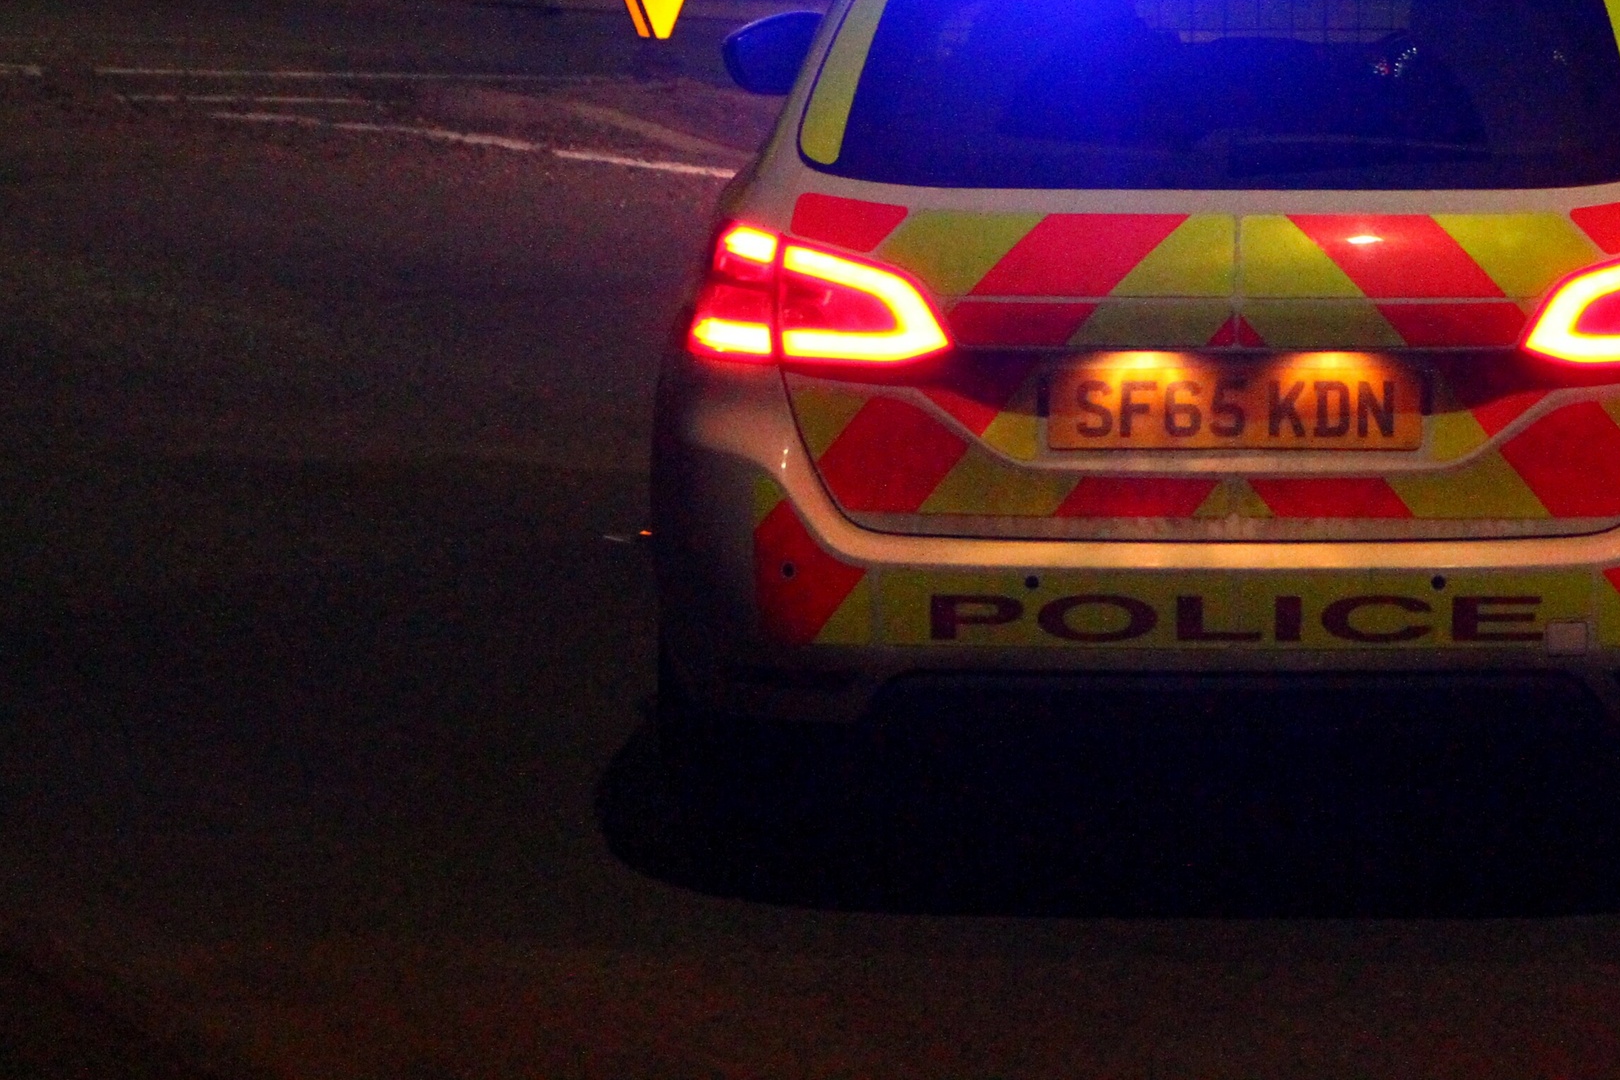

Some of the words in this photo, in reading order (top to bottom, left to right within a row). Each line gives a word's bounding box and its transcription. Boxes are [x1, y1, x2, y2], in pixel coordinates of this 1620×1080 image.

[1075, 380, 1246, 439] SF65
[1267, 380, 1396, 439] KDN
[929, 593, 1544, 643] POLICE
